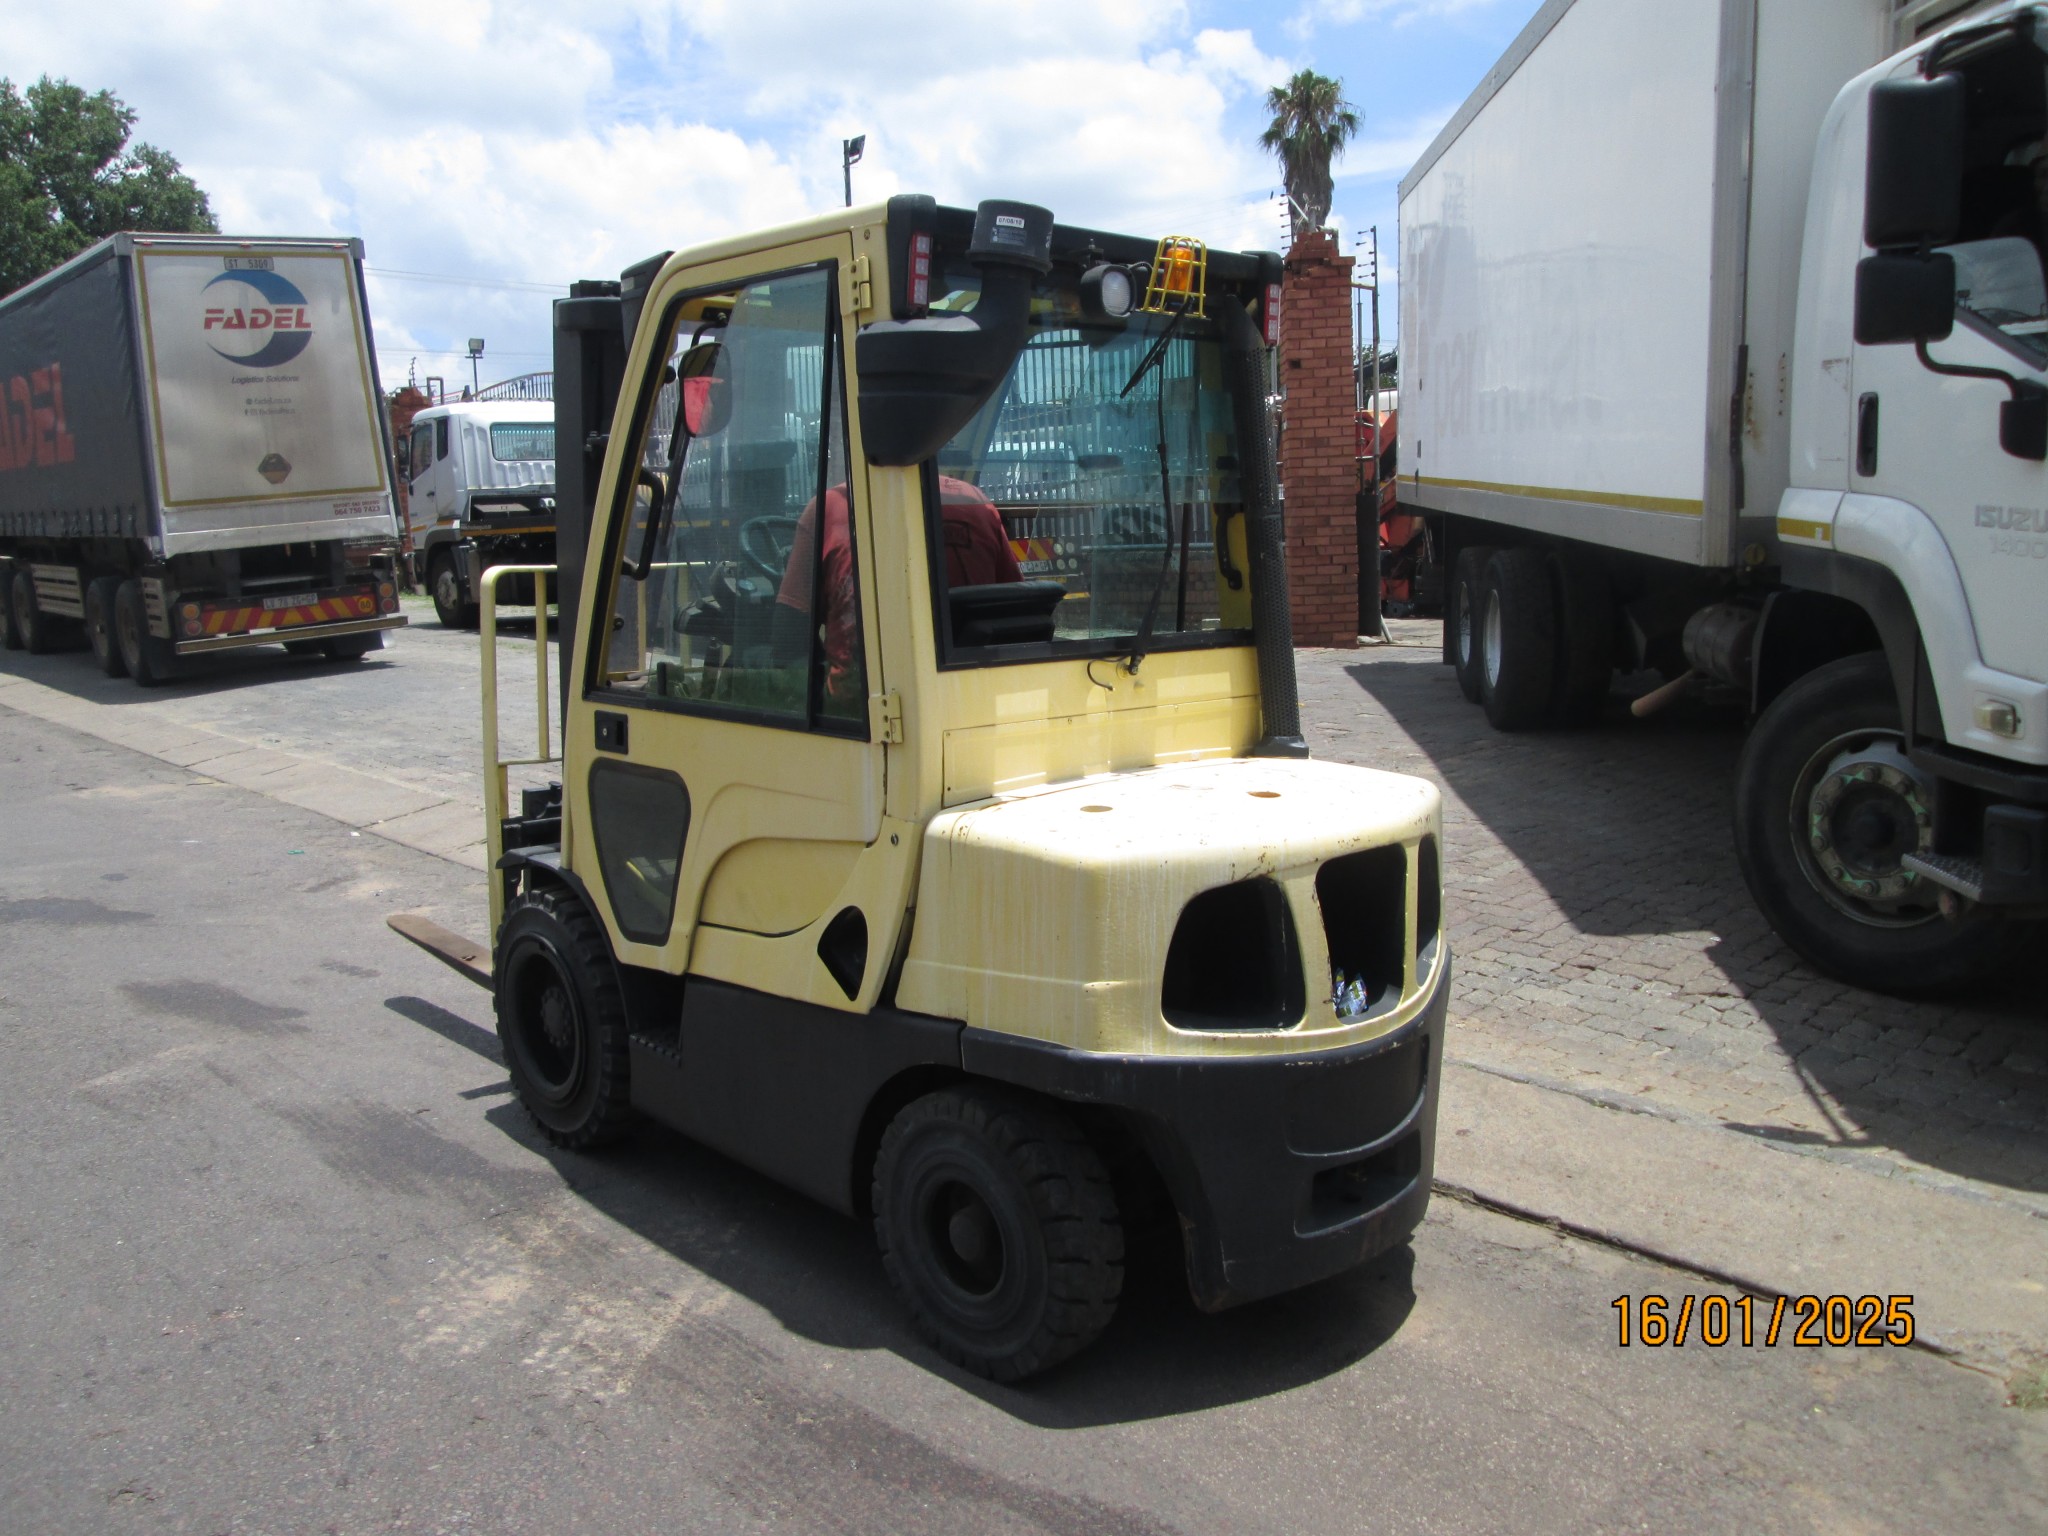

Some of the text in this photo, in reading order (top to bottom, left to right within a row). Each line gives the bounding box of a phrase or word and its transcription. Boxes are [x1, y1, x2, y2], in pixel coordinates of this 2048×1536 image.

[203, 308, 312, 330] FADEL
[231, 375, 299, 385] Logistics Solutions
[1975, 504, 2048, 533] ISUZU
